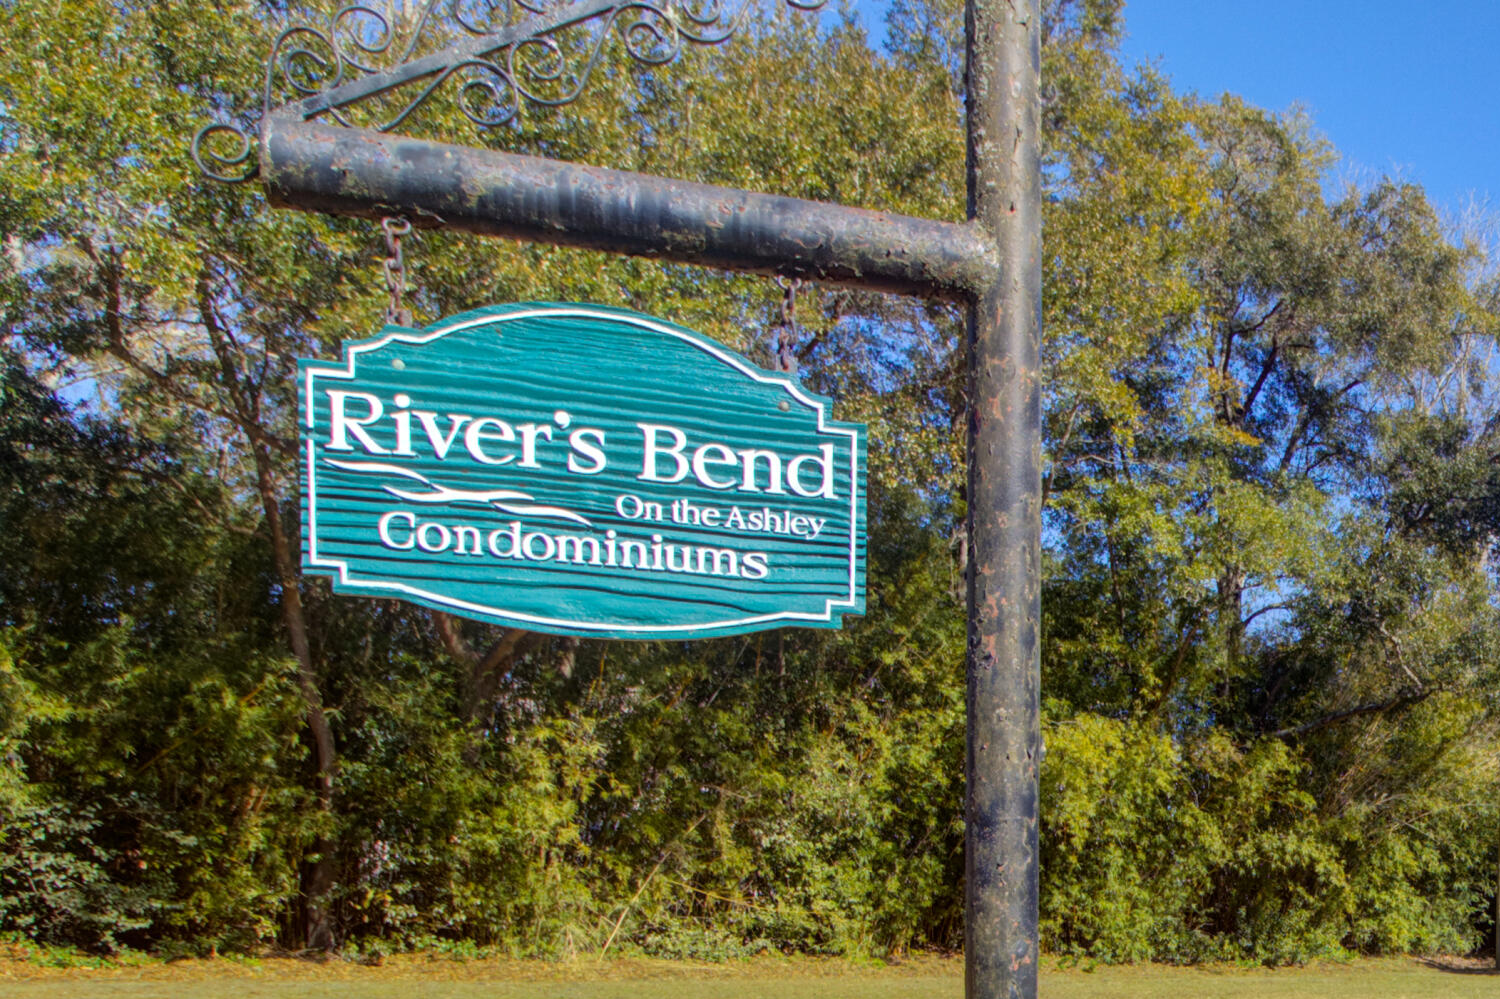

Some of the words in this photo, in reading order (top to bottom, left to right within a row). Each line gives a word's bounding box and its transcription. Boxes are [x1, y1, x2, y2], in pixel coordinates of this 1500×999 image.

[325, 389, 606, 474] River's
[638, 424, 838, 499] Bend
[378, 512, 768, 579] Condominiums
[616, 496, 663, 521] On
[672, 501, 720, 527] the
[726, 505, 826, 538] Ashley
